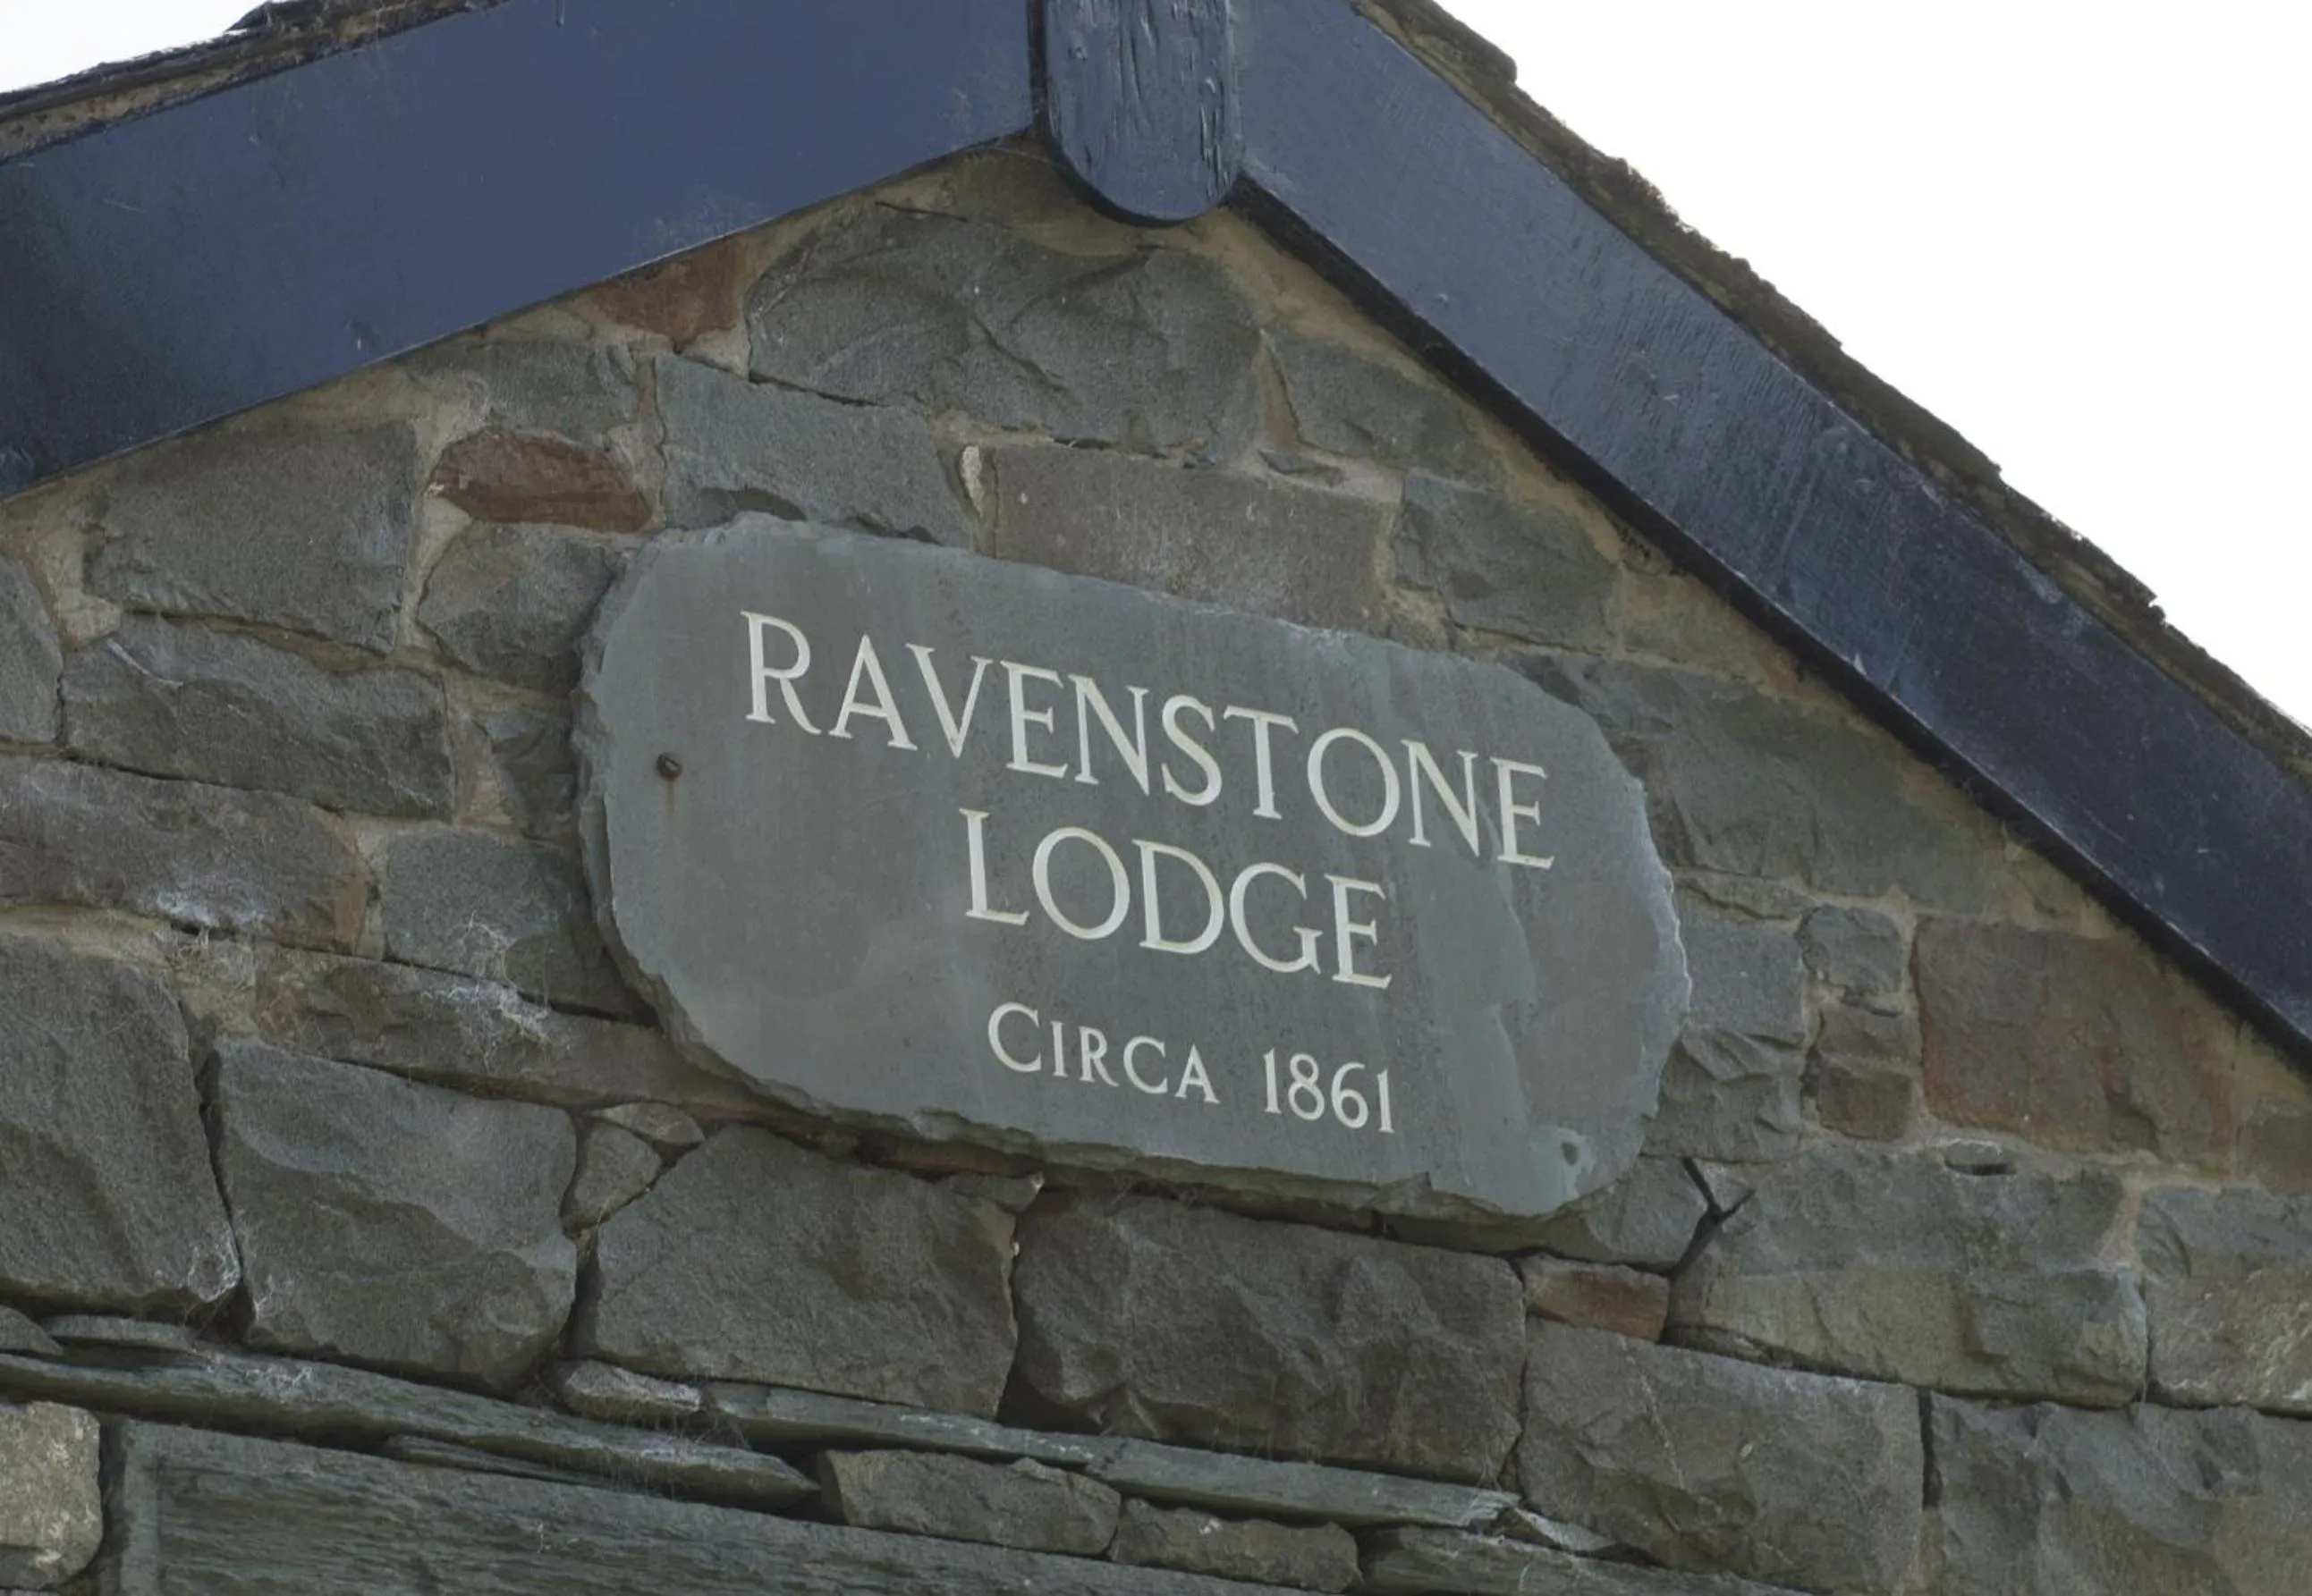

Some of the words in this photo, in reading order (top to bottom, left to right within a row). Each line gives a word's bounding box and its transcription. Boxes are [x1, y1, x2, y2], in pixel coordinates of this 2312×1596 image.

[741, 611, 1554, 869] RAVENSTONE
[959, 807, 1392, 989] LODGE
[987, 1002, 1219, 1104] CIRCA
[1263, 1050, 1393, 1133] 1861
